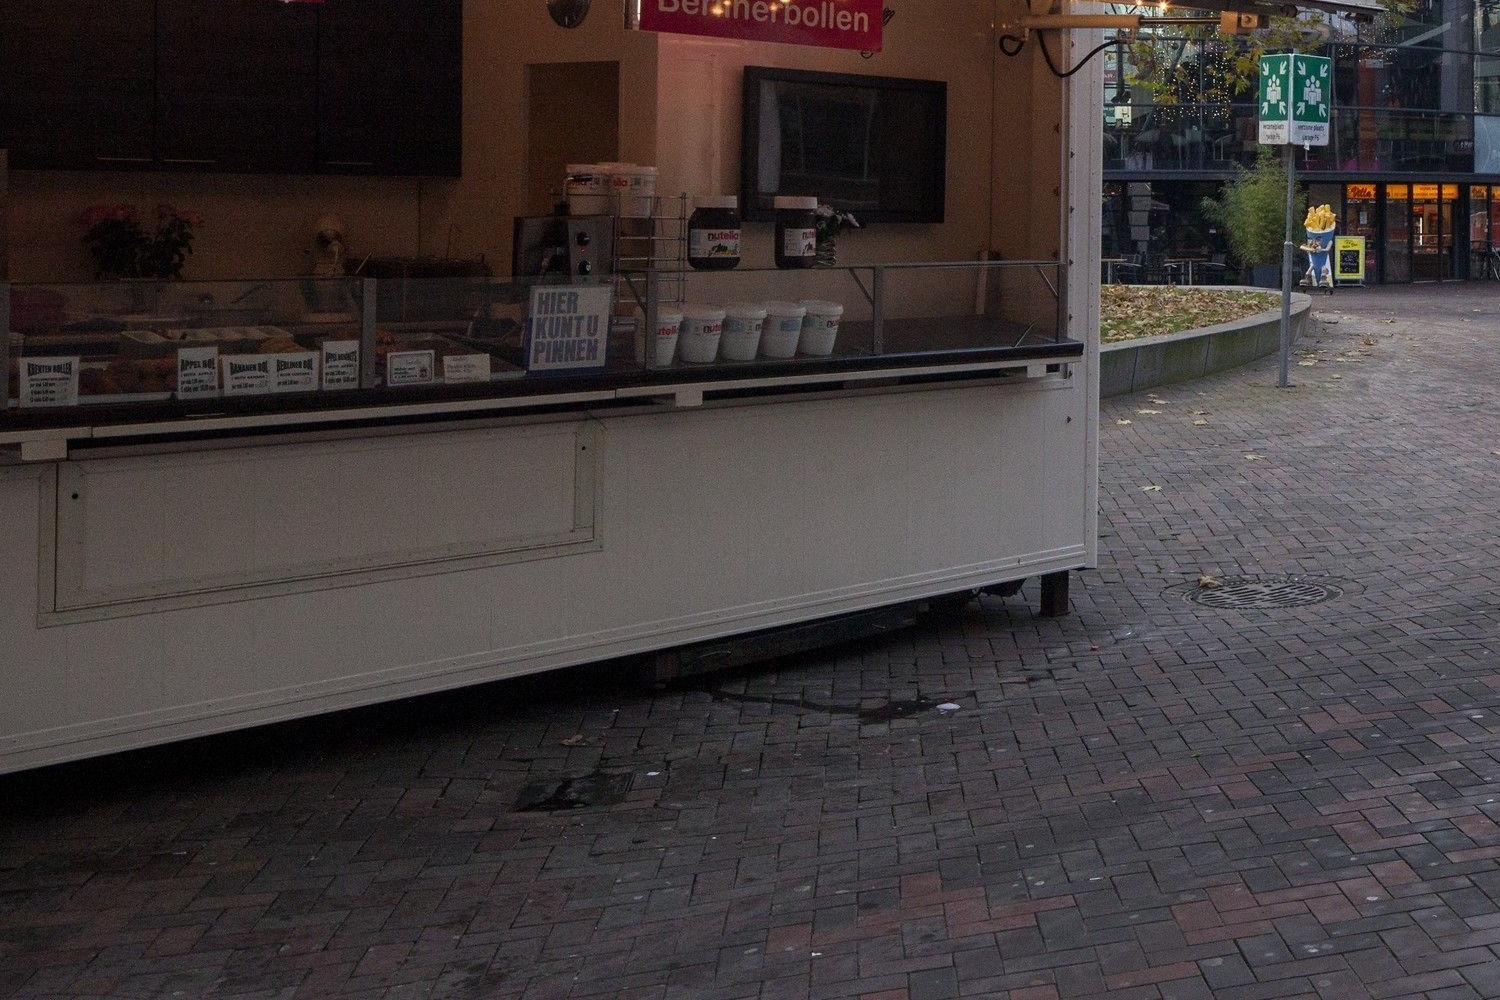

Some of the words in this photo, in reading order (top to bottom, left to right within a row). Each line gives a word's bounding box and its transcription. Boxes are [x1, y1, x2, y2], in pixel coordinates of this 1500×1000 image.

[708, 231, 739, 242] nutella
[537, 292, 579, 314] HIER
[535, 316, 584, 339] KUNT
[587, 315, 599, 337] U
[533, 339, 598, 364] PINNEN
